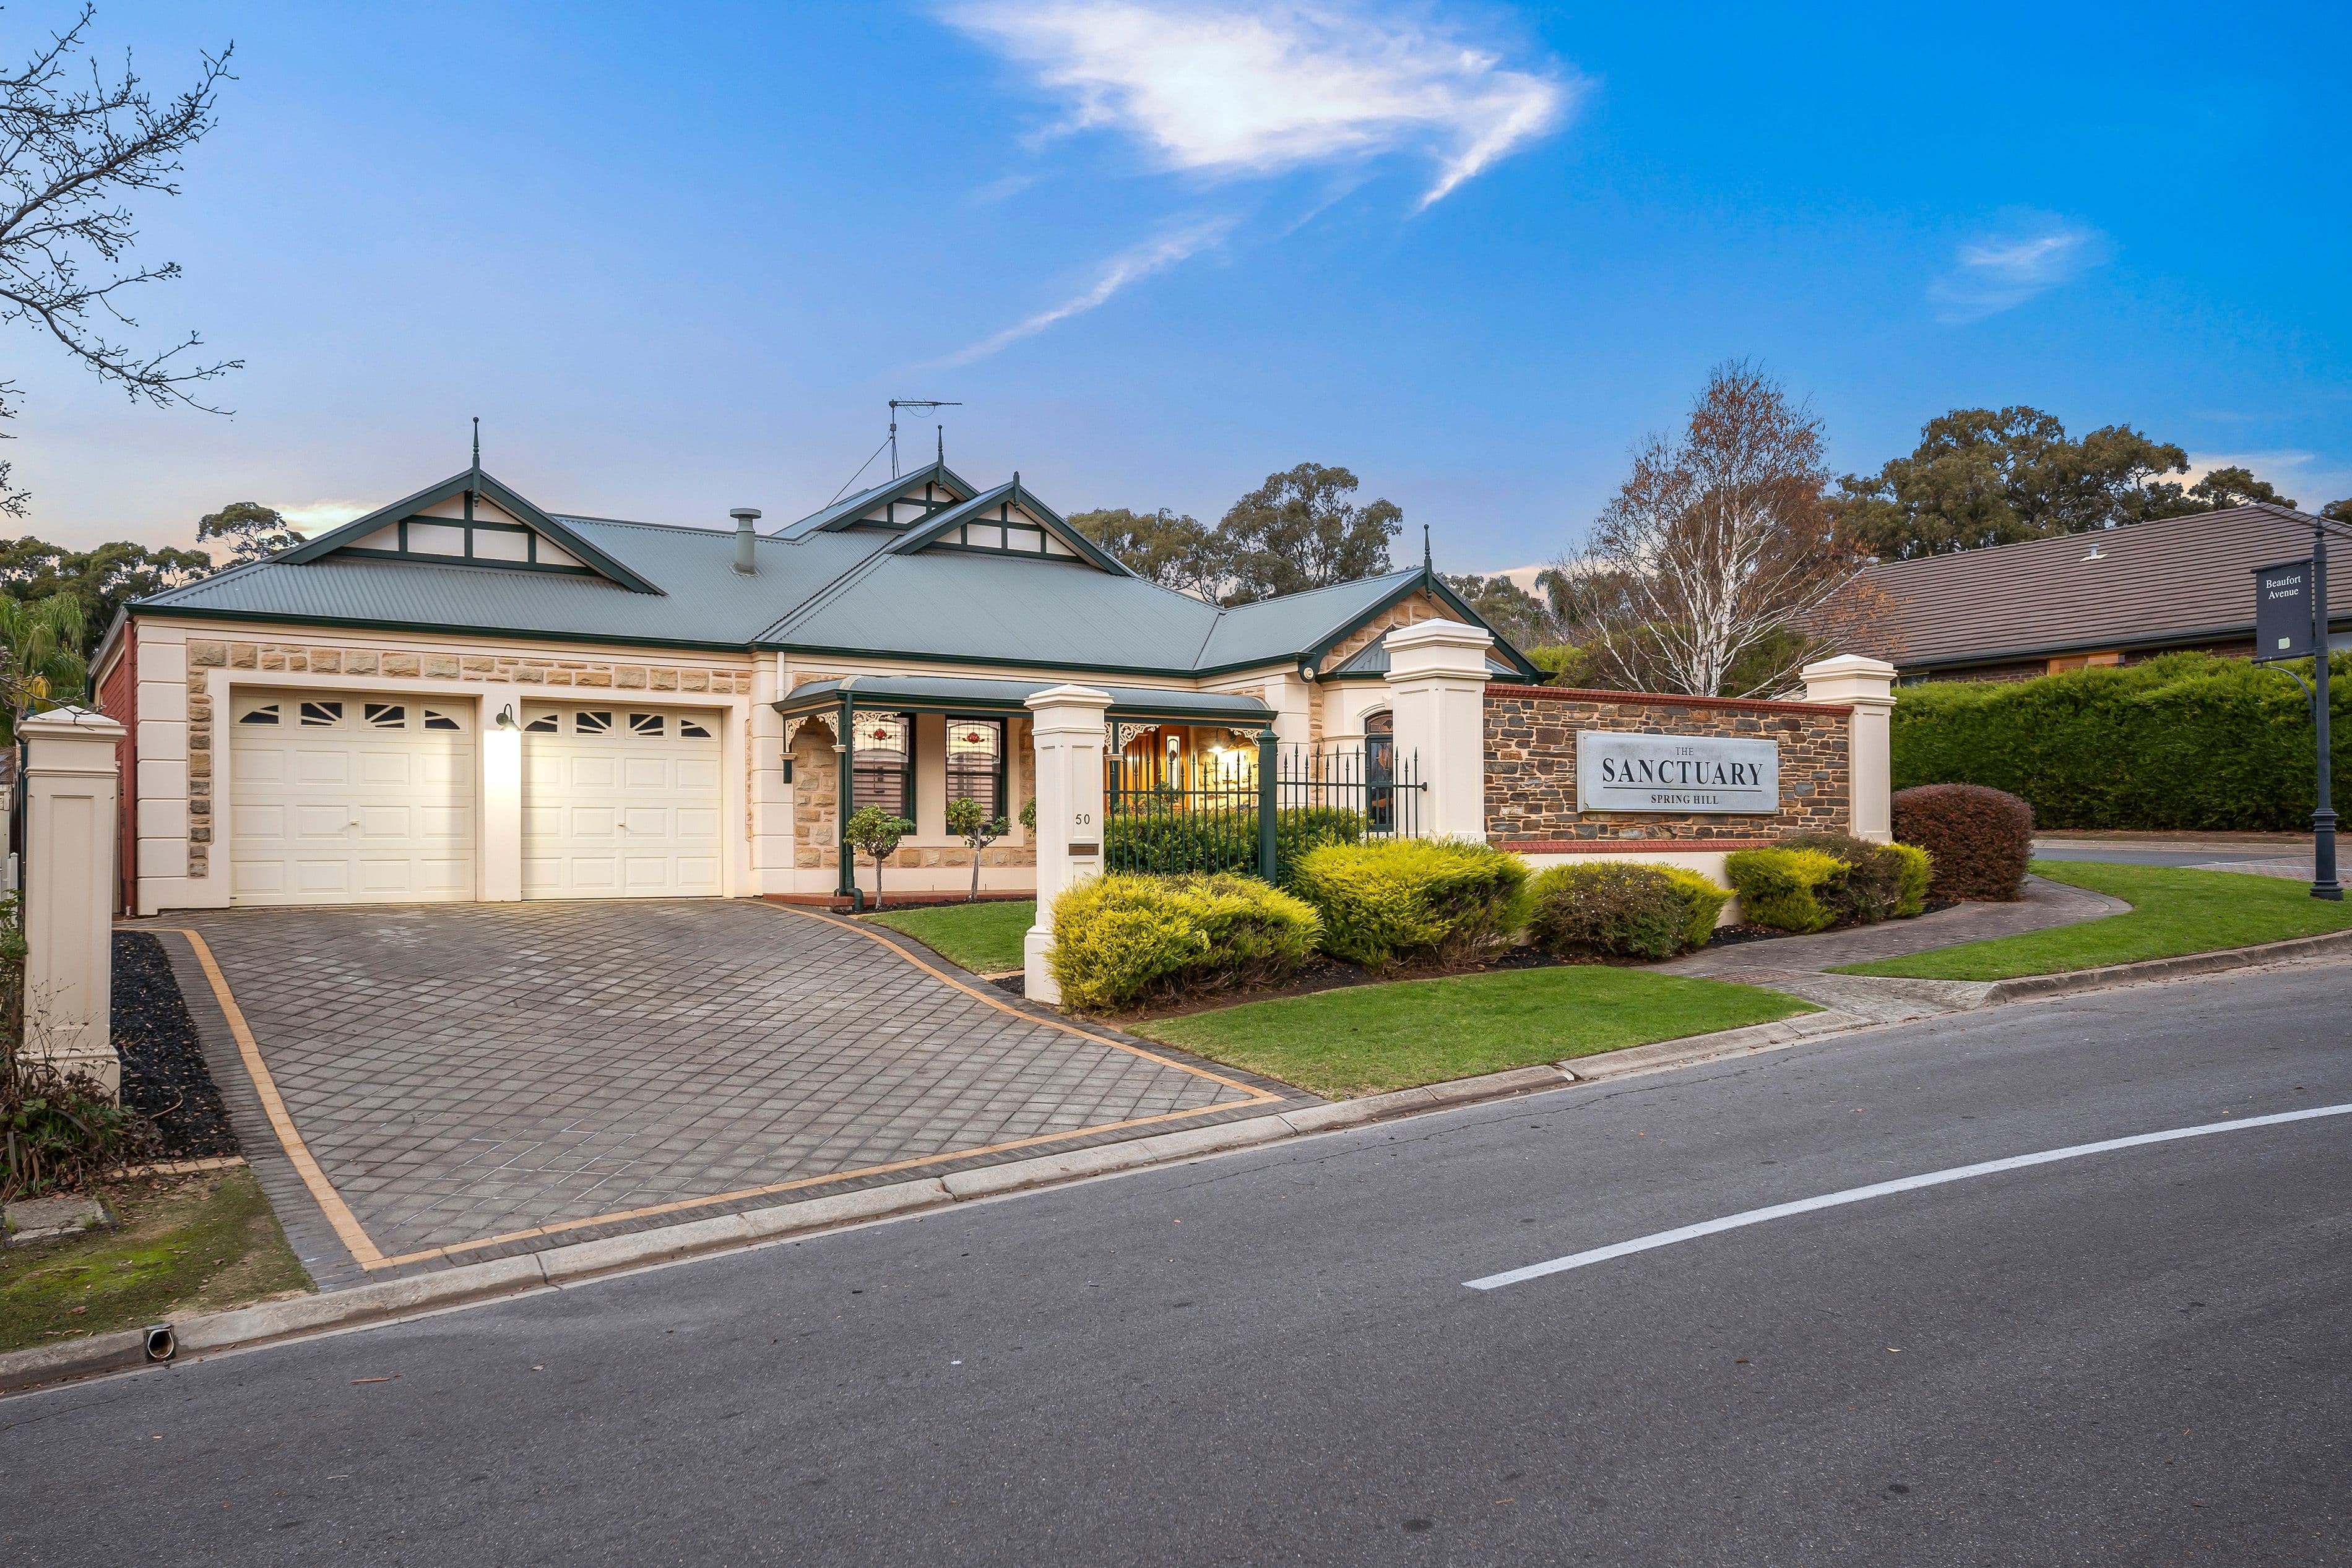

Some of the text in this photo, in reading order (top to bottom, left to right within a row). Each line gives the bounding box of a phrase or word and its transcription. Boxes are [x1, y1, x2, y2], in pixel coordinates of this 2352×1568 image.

[2266, 575, 2301, 588] Beaufort
[2268, 588, 2299, 600] Avenue
[1675, 747, 1694, 756] THE
[1602, 757, 1763, 786] SANCTUARY
[1651, 795, 1719, 804] SPRING HILL
[1075, 814, 1090, 825] 50
